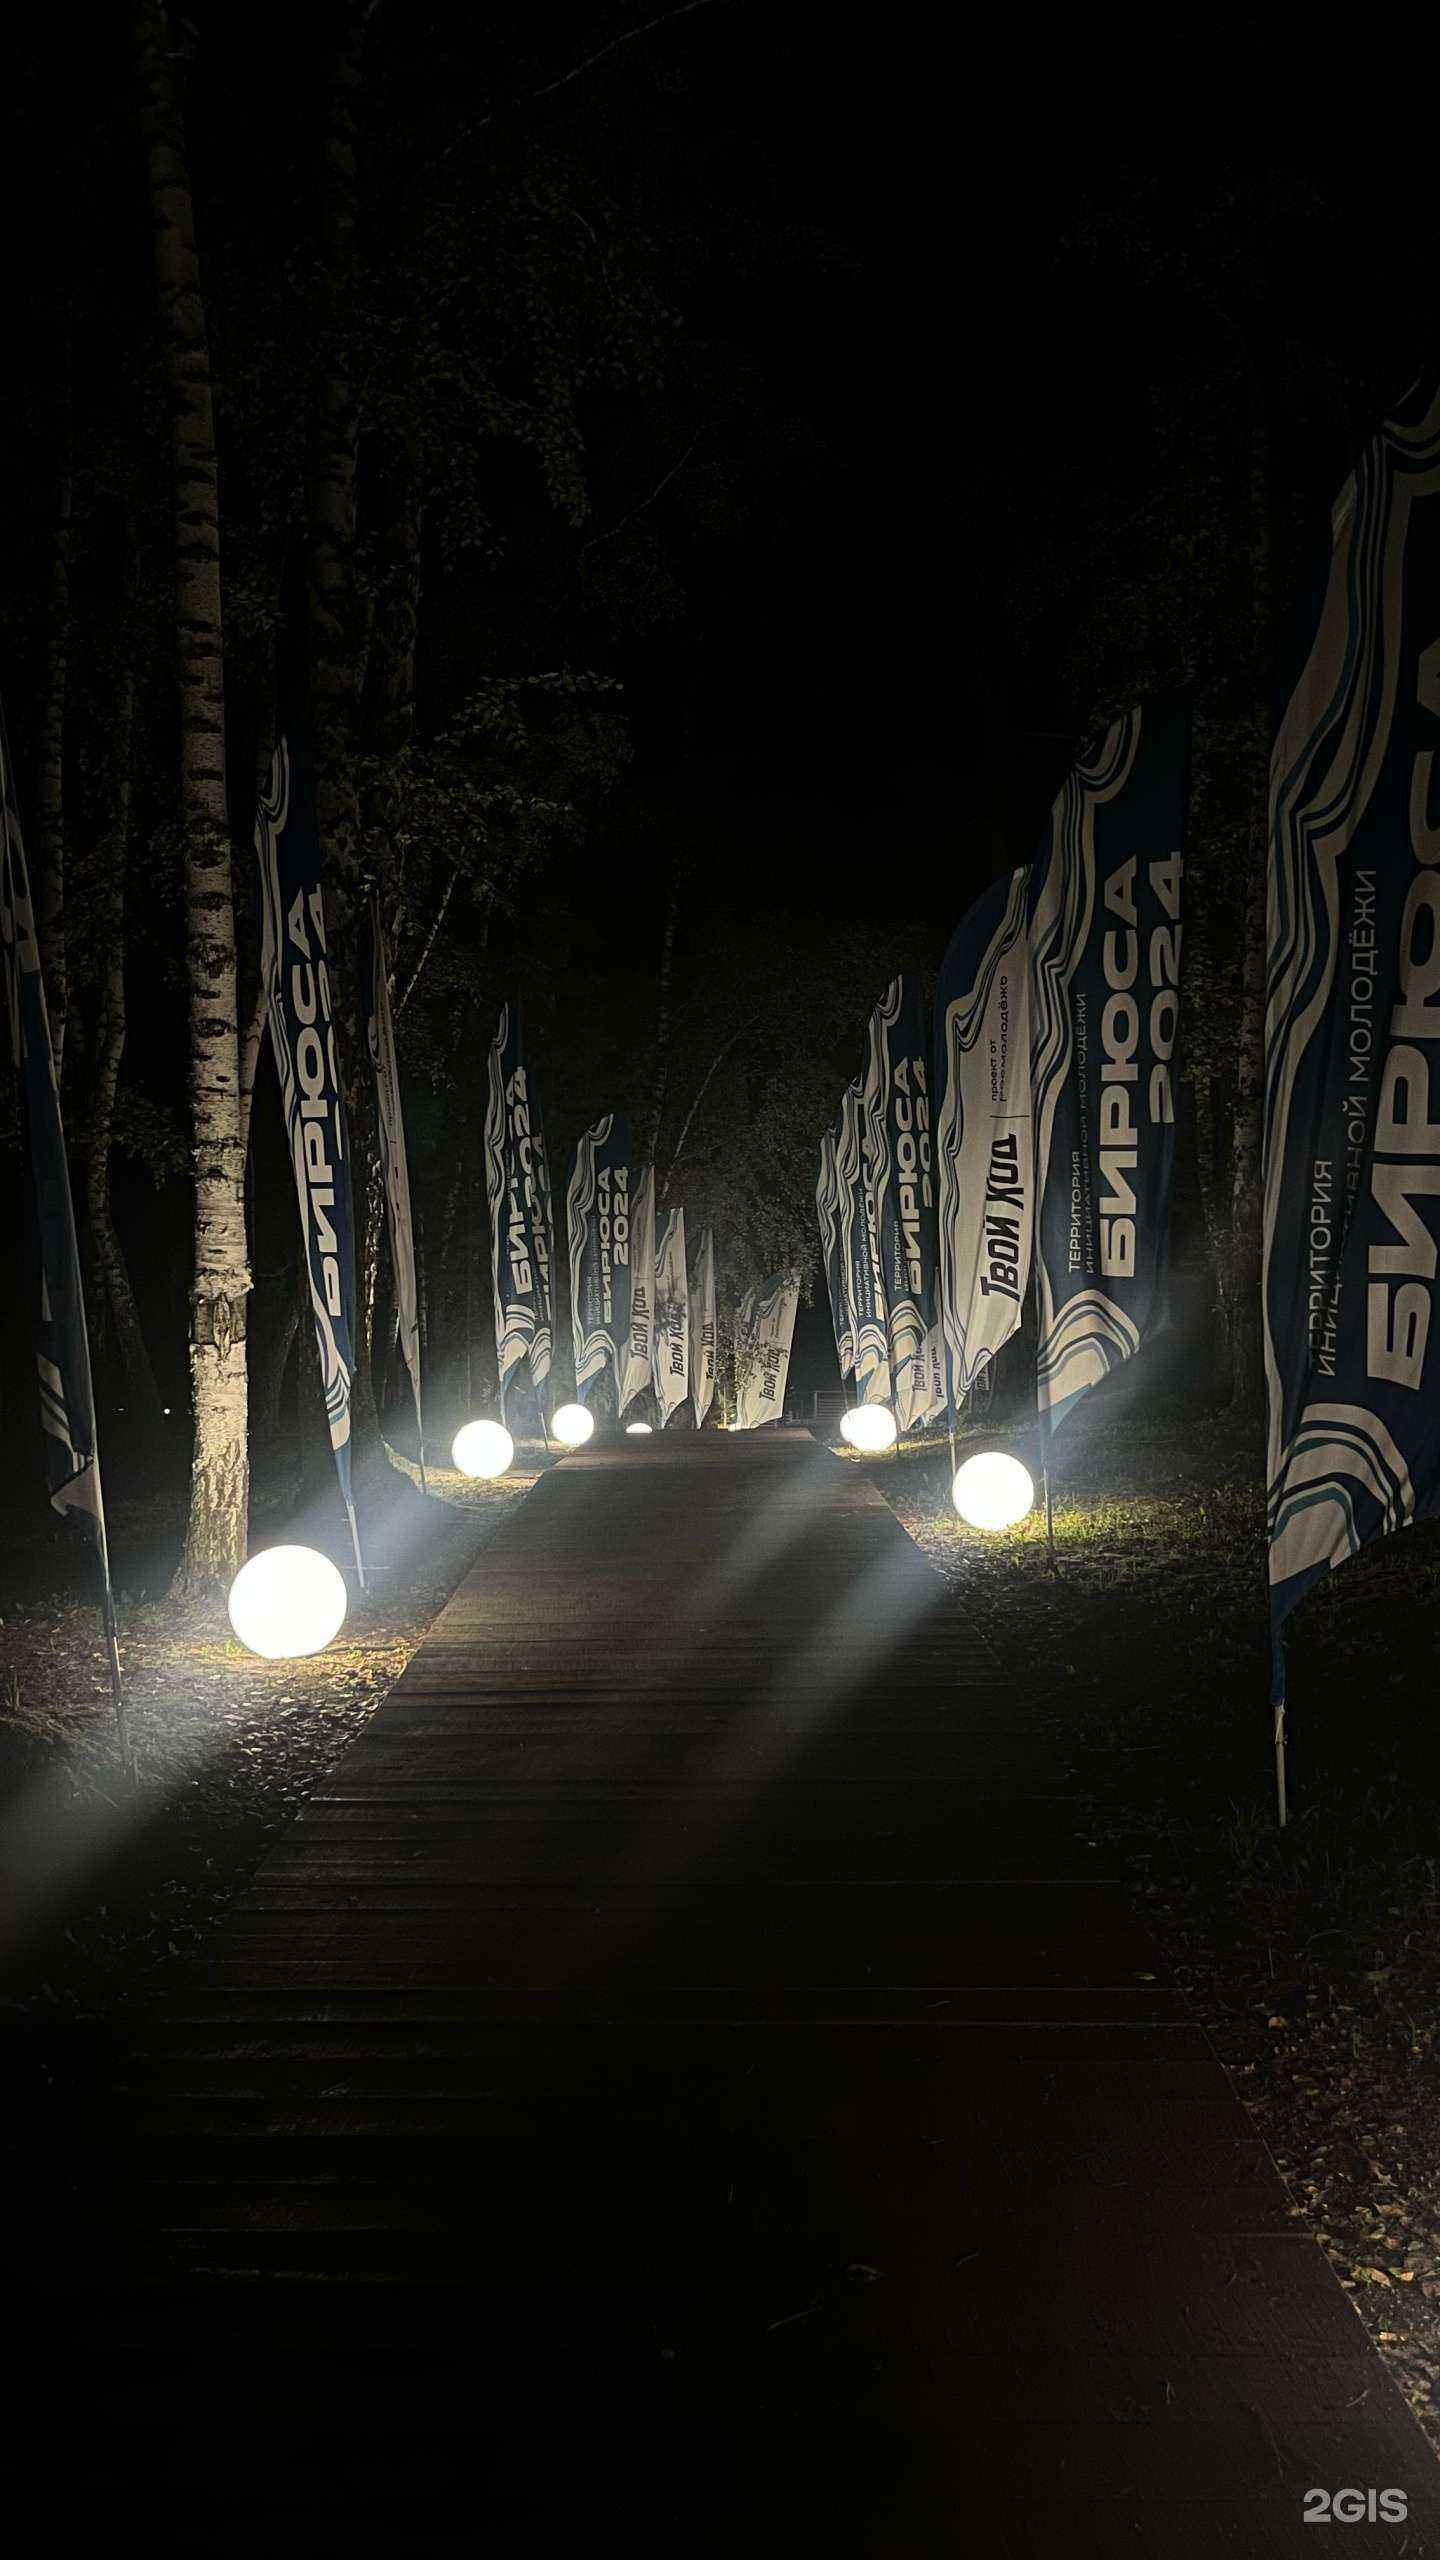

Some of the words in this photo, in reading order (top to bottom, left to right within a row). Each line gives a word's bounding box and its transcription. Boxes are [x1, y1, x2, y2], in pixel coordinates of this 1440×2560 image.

[989, 1039, 998, 1055] от
[1100, 853, 1140, 1279] БИРЮСА
[1149, 850, 1182, 1125] 2024
[1346, 868, 1378, 1083] МОЛОДЁЖИ
[287, 886, 341, 1317] БИРЮСА
[989, 1058, 999, 1102] проект
[597, 1166, 612, 1323] БИРЮСА
[613, 1165, 629, 1266] 2024
[893, 1057, 923, 1294] БИРЮСА
[1068, 1151, 1082, 1274] ТЕРРИТОРИЯ
